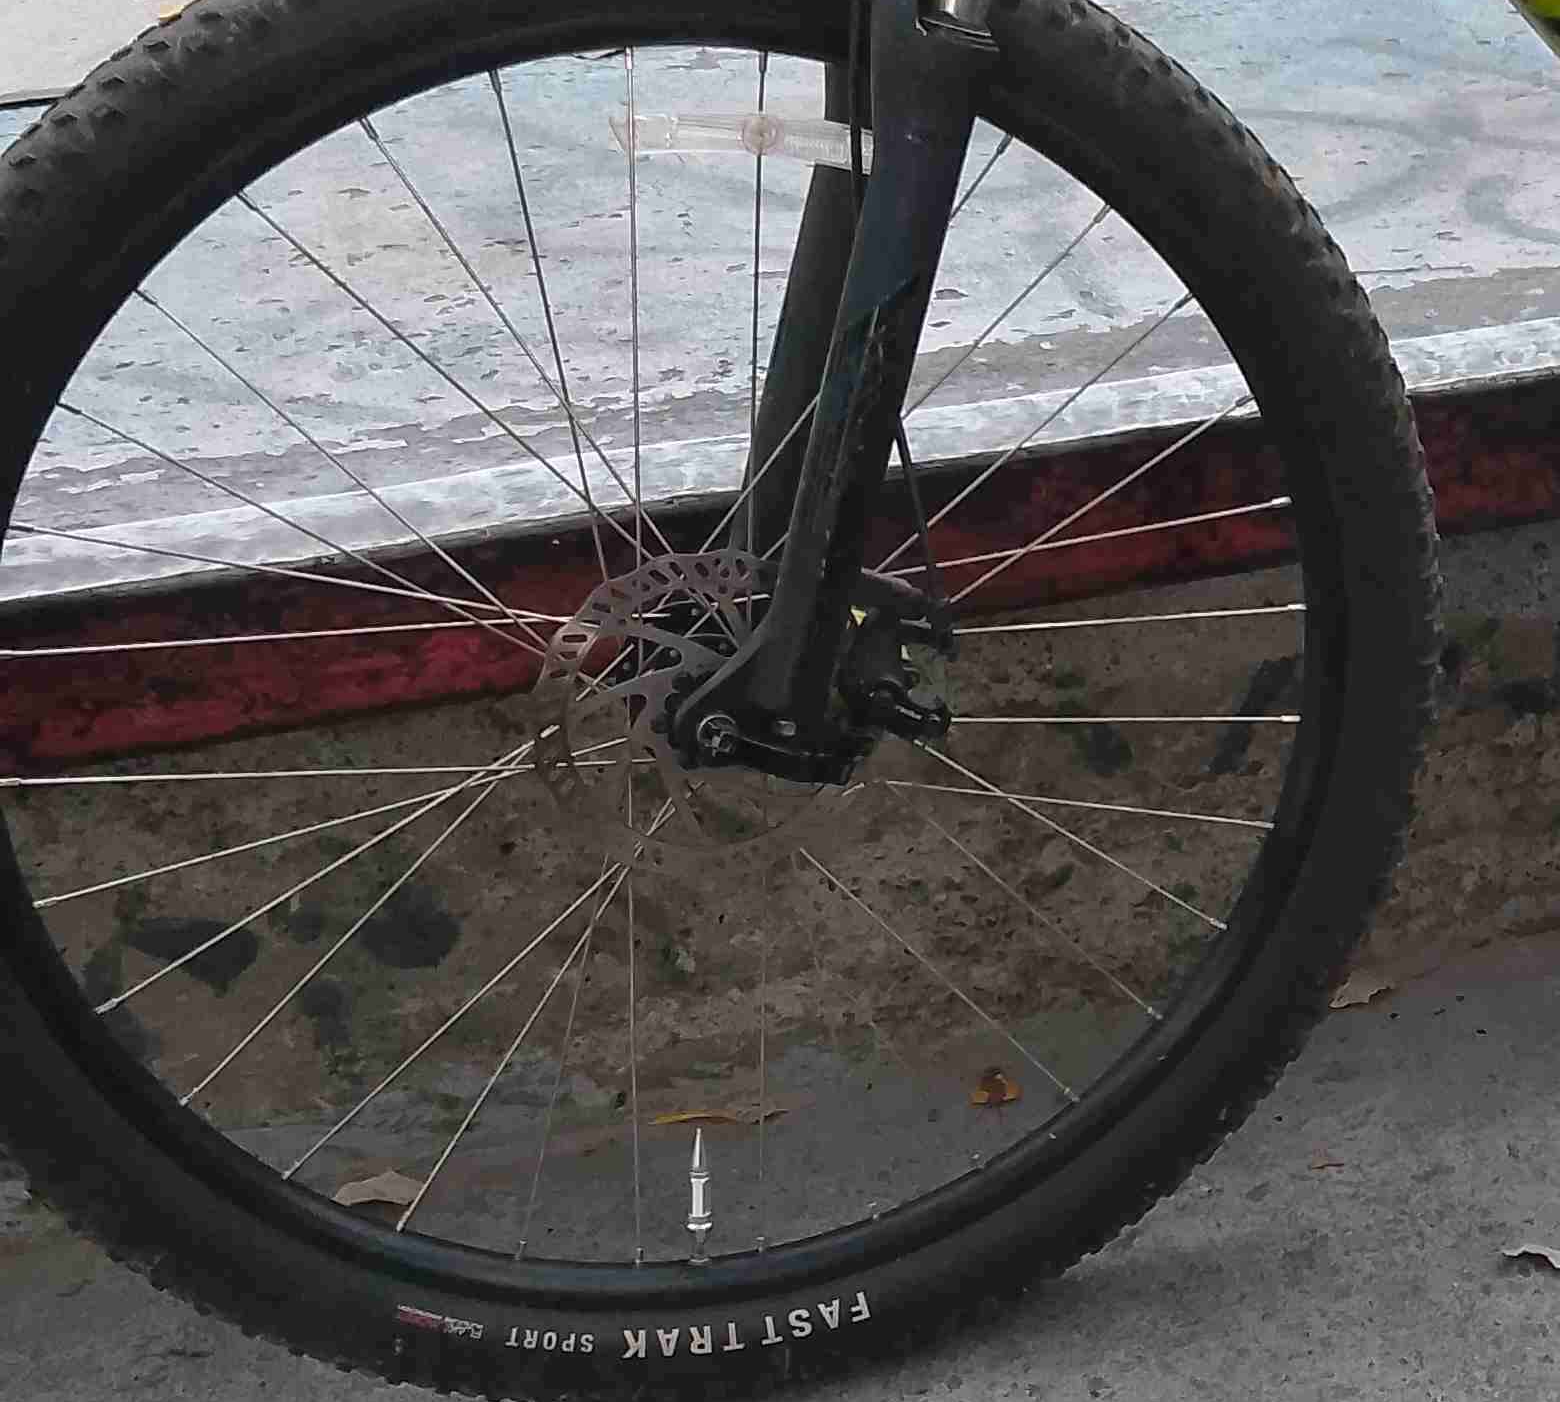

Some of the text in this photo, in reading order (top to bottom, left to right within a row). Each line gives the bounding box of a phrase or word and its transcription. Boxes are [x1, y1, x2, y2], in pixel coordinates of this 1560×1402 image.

[504, 1291, 873, 1360] FAST TRAK SPORT
